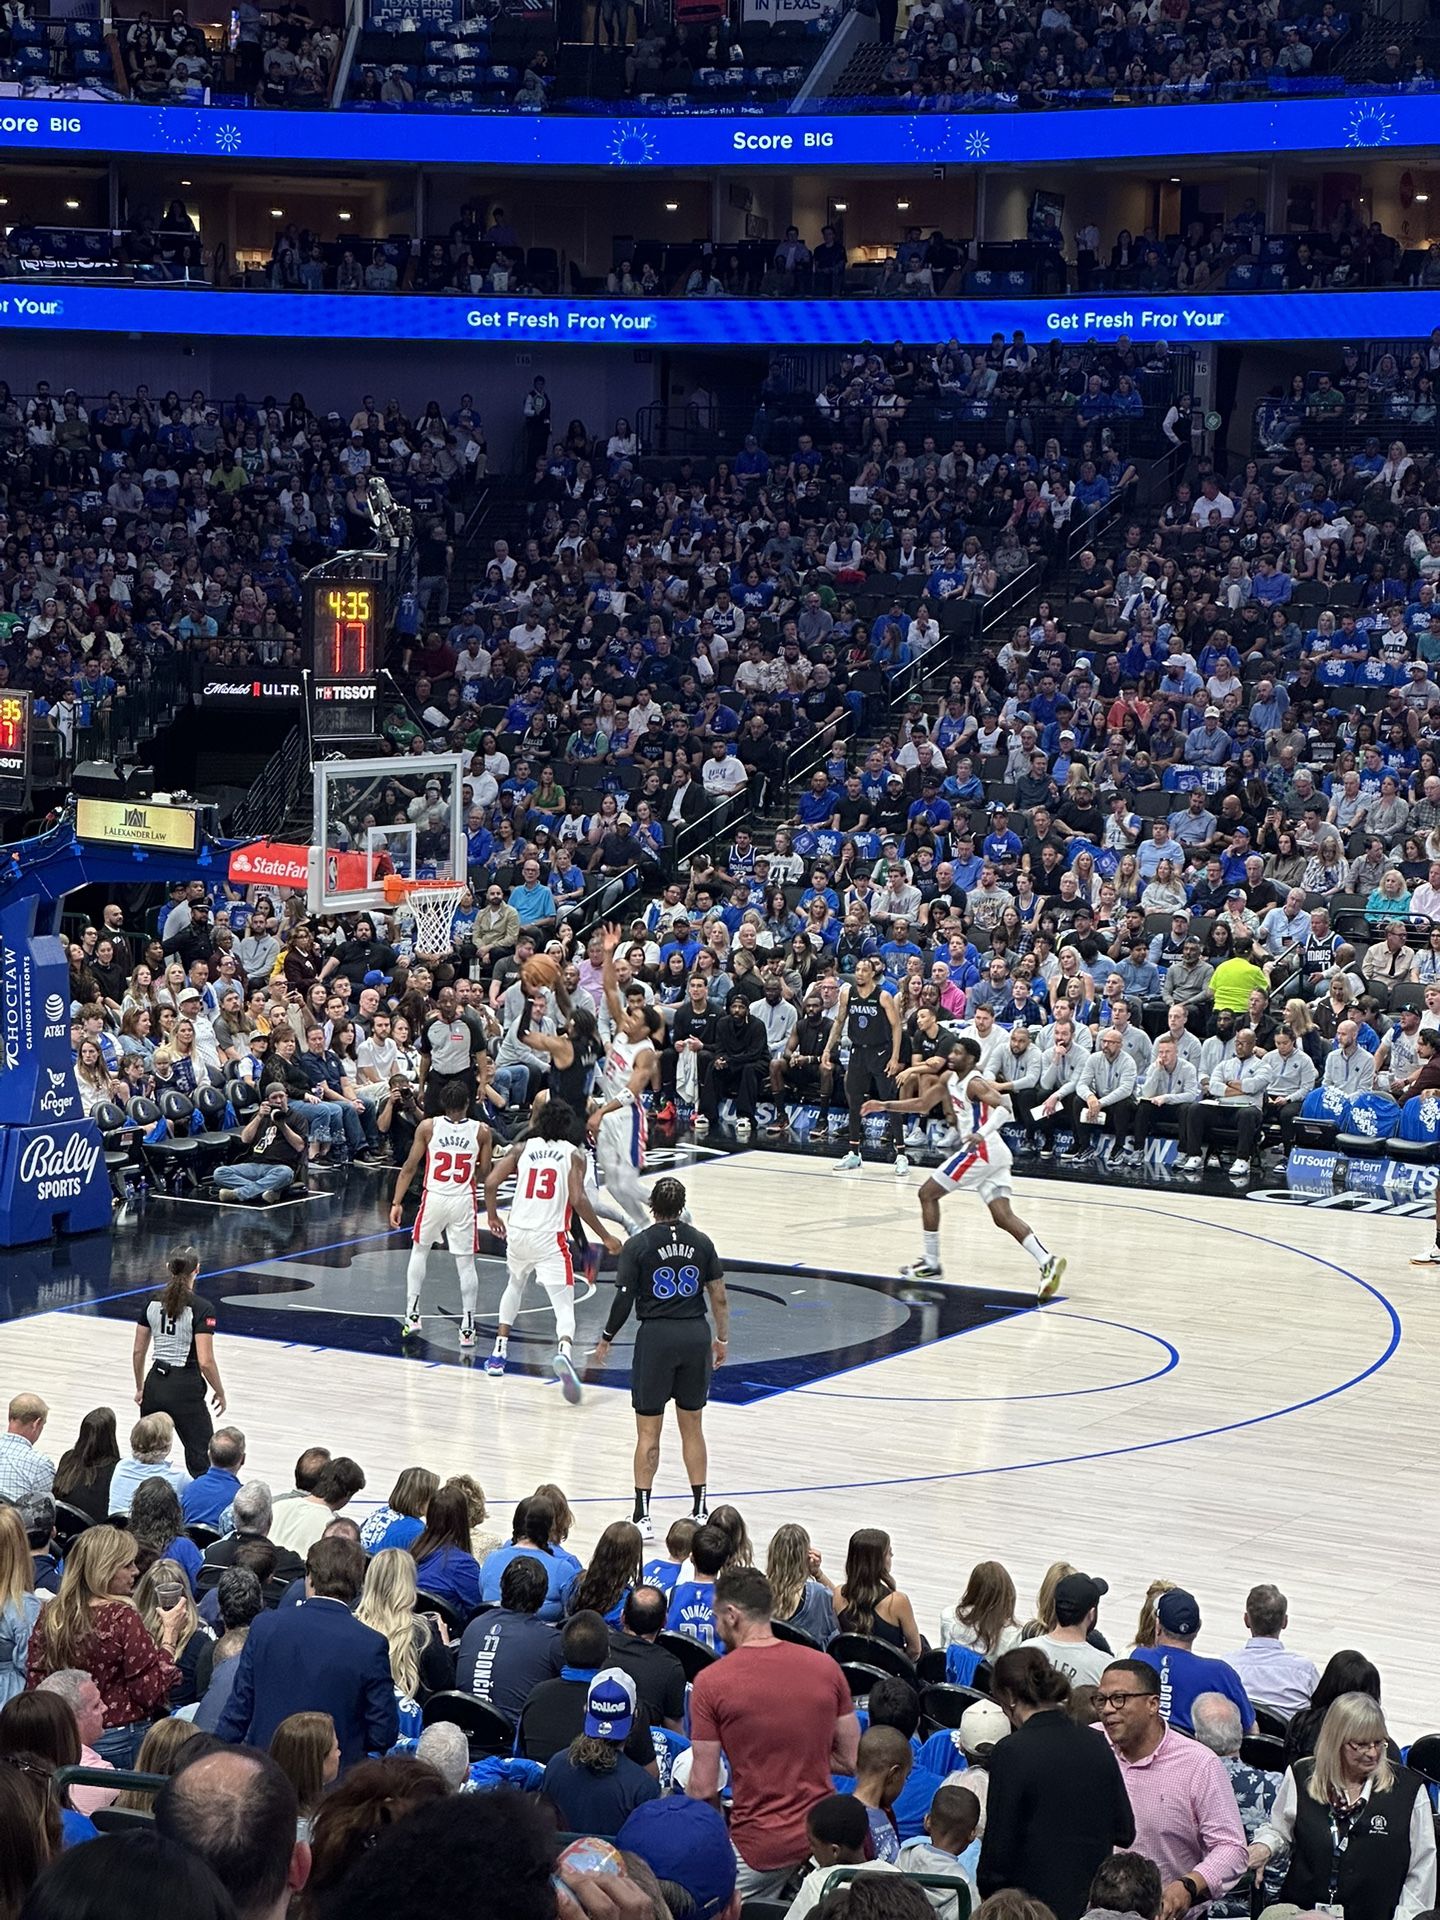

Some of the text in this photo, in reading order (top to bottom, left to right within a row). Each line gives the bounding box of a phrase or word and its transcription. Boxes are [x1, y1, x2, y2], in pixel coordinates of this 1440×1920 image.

[775, 0, 821, 10] TEXAS
[0, 117, 82, 133] ore BIG
[733, 131, 834, 151] Score BIG
[466, 310, 502, 327] Get
[507, 311, 560, 329] Fresh
[1046, 313, 1079, 330] Get
[1084, 311, 1134, 329] Fresh
[328, 591, 369, 620] 4:35
[335, 622, 366, 674] 17
[203, 682, 302, 697] Michelob ULTR
[334, 685, 377, 700] TISSOT
[0, 757, 24, 769] SOT
[24, 956, 32, 1001] RESORTS
[5, 947, 20, 1058] CHOCTAW
[44, 1024, 66, 1039] AT&T
[40, 1091, 74, 1118] Kroger
[438, 1136, 471, 1150] SASSER
[20, 1132, 100, 1184] Bally
[433, 1151, 473, 1184] 25
[37, 1176, 81, 1200] SPORTS
[525, 1168, 558, 1200] 13
[657, 1243, 695, 1260] MORRIS
[652, 1264, 700, 1299] 88
